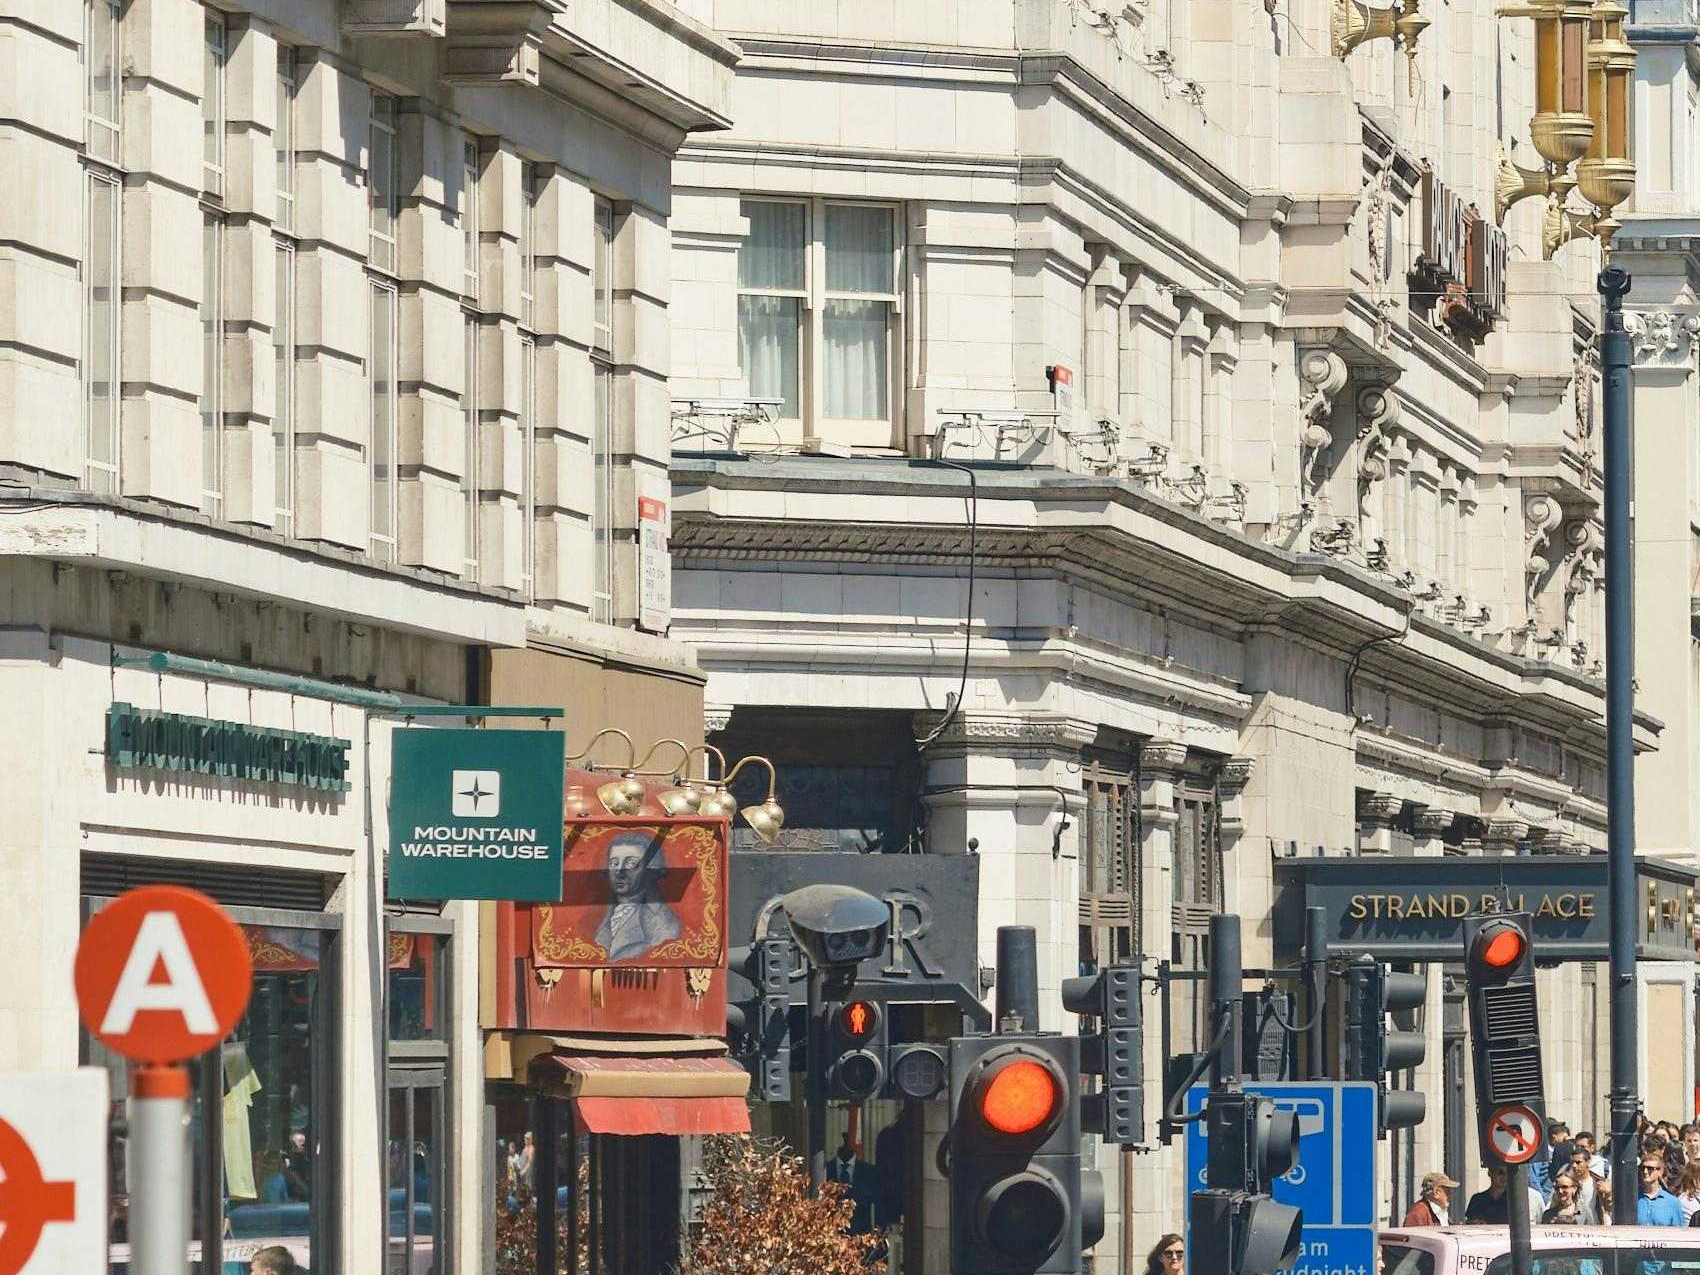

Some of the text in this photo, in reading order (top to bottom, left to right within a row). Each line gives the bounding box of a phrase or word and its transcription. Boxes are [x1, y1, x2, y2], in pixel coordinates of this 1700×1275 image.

[414, 826, 536, 843] MOUNTAIN
[400, 844, 549, 860] WAREHOUSE
[1350, 894, 1470, 918] STRAND
[100, 911, 219, 1034] A
